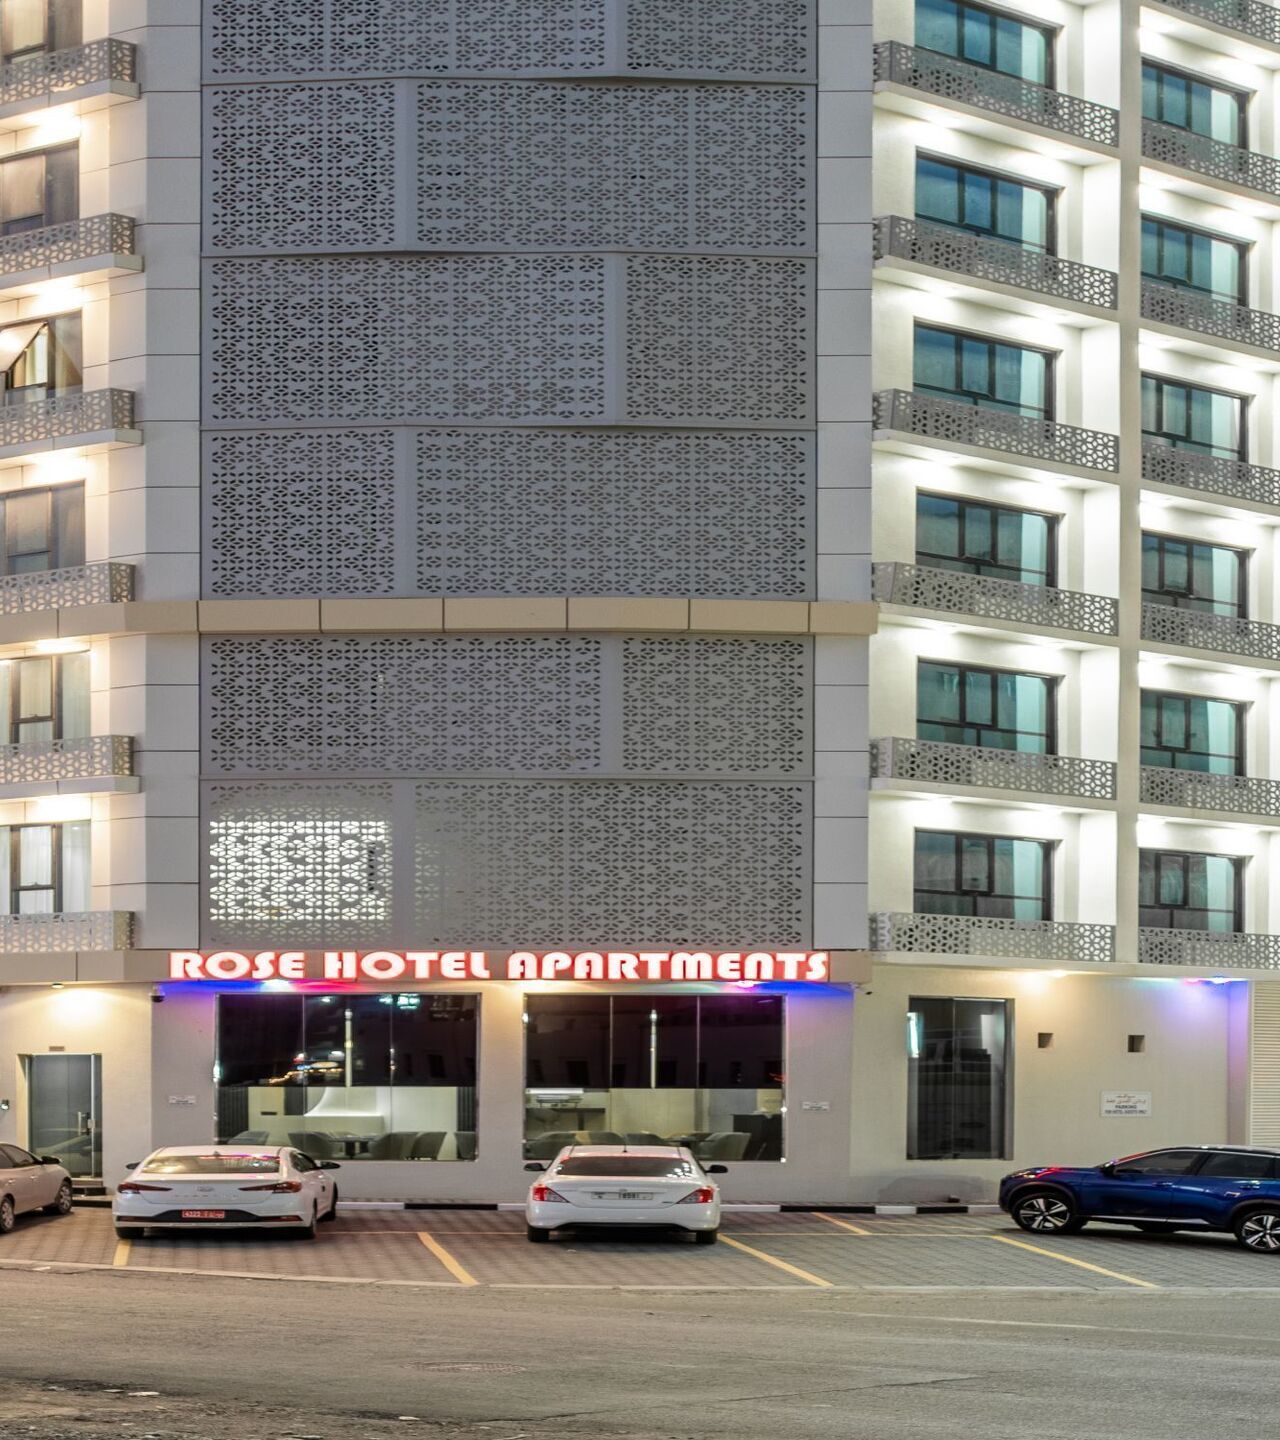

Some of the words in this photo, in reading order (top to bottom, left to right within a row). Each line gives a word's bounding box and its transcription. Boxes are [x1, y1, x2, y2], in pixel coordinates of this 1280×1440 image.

[168, 951, 306, 980] ROSE
[323, 951, 491, 980] HOTEL
[506, 951, 828, 980] APARTMENTS
